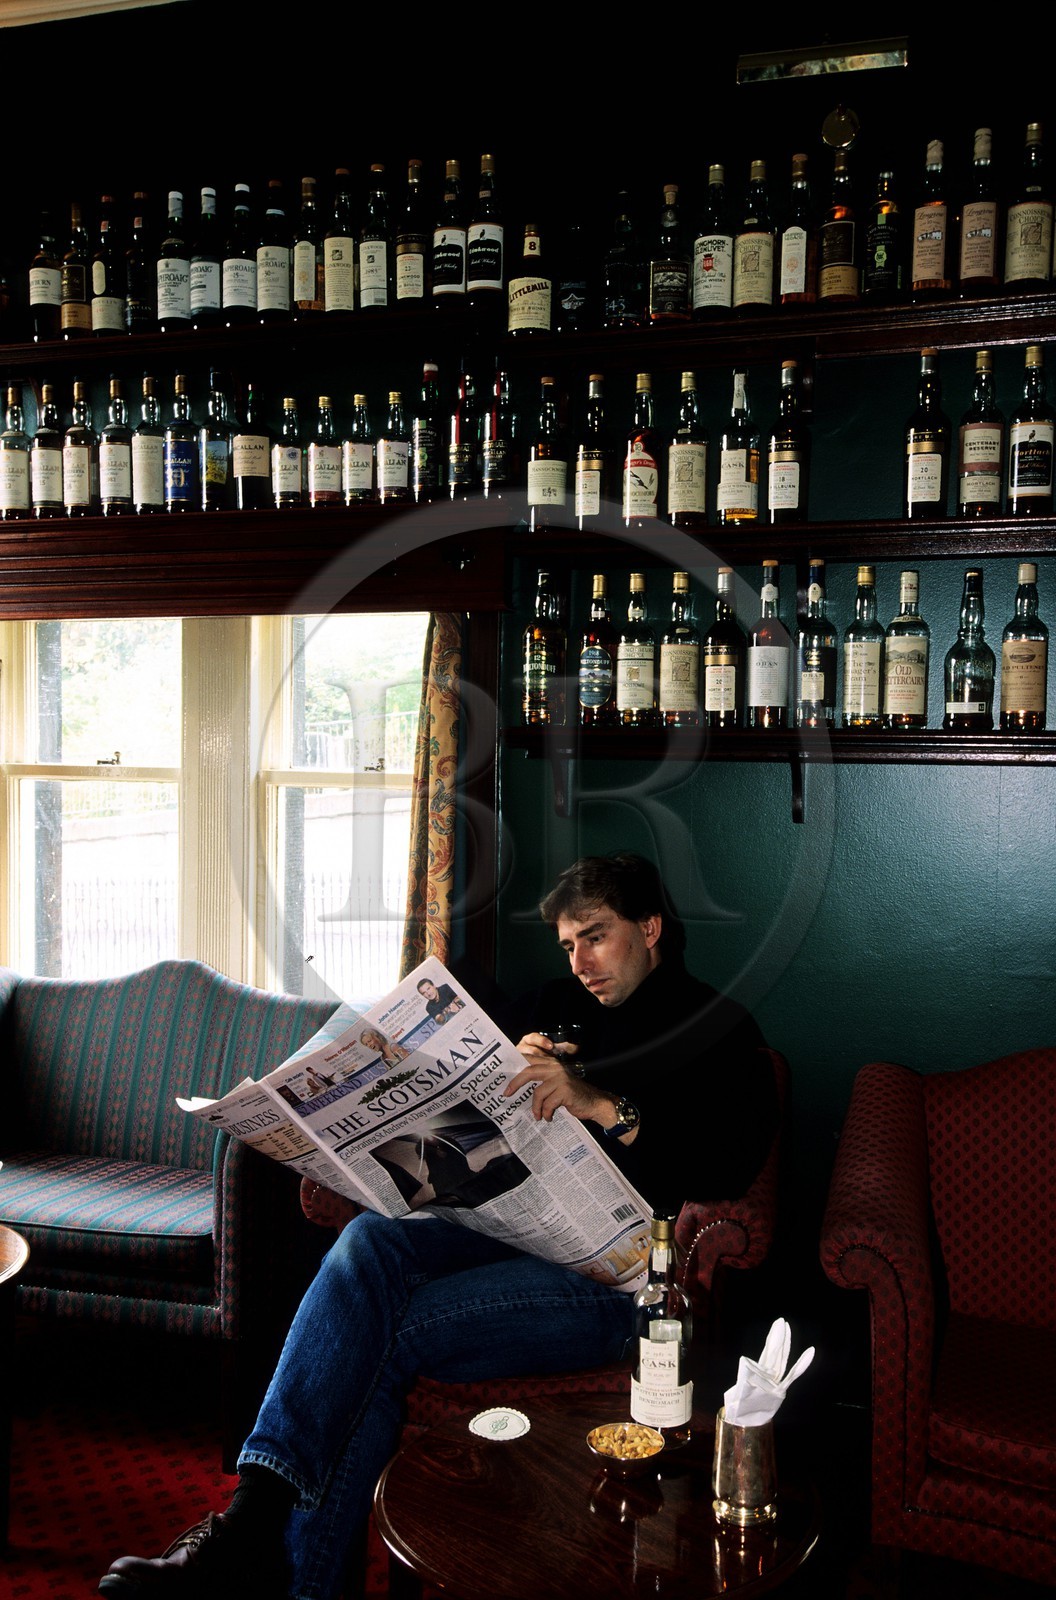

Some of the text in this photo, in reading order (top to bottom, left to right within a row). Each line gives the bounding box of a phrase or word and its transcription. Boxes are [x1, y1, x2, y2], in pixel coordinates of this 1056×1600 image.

[528, 241, 537, 250] 8
[509, 282, 549, 303] LITTLEMILL
[894, 664, 912, 675] OLD
[378, 998, 406, 1024] John Hansen
[322, 1110, 371, 1142] THE
[366, 1029, 485, 1120] SCOTSMAN
[460, 1053, 504, 1095] Special
[306, 1079, 363, 1112] WEEKEND
[470, 1071, 507, 1106] forces
[482, 1092, 507, 1117] pile
[493, 1081, 539, 1126] pressure
[230, 1108, 281, 1137] BUSINESS
[339, 1090, 460, 1161] Celebrating St Andrew's Day with pride
[642, 1358, 677, 1368] CASK
[658, 1390, 685, 1398] WHISKY
